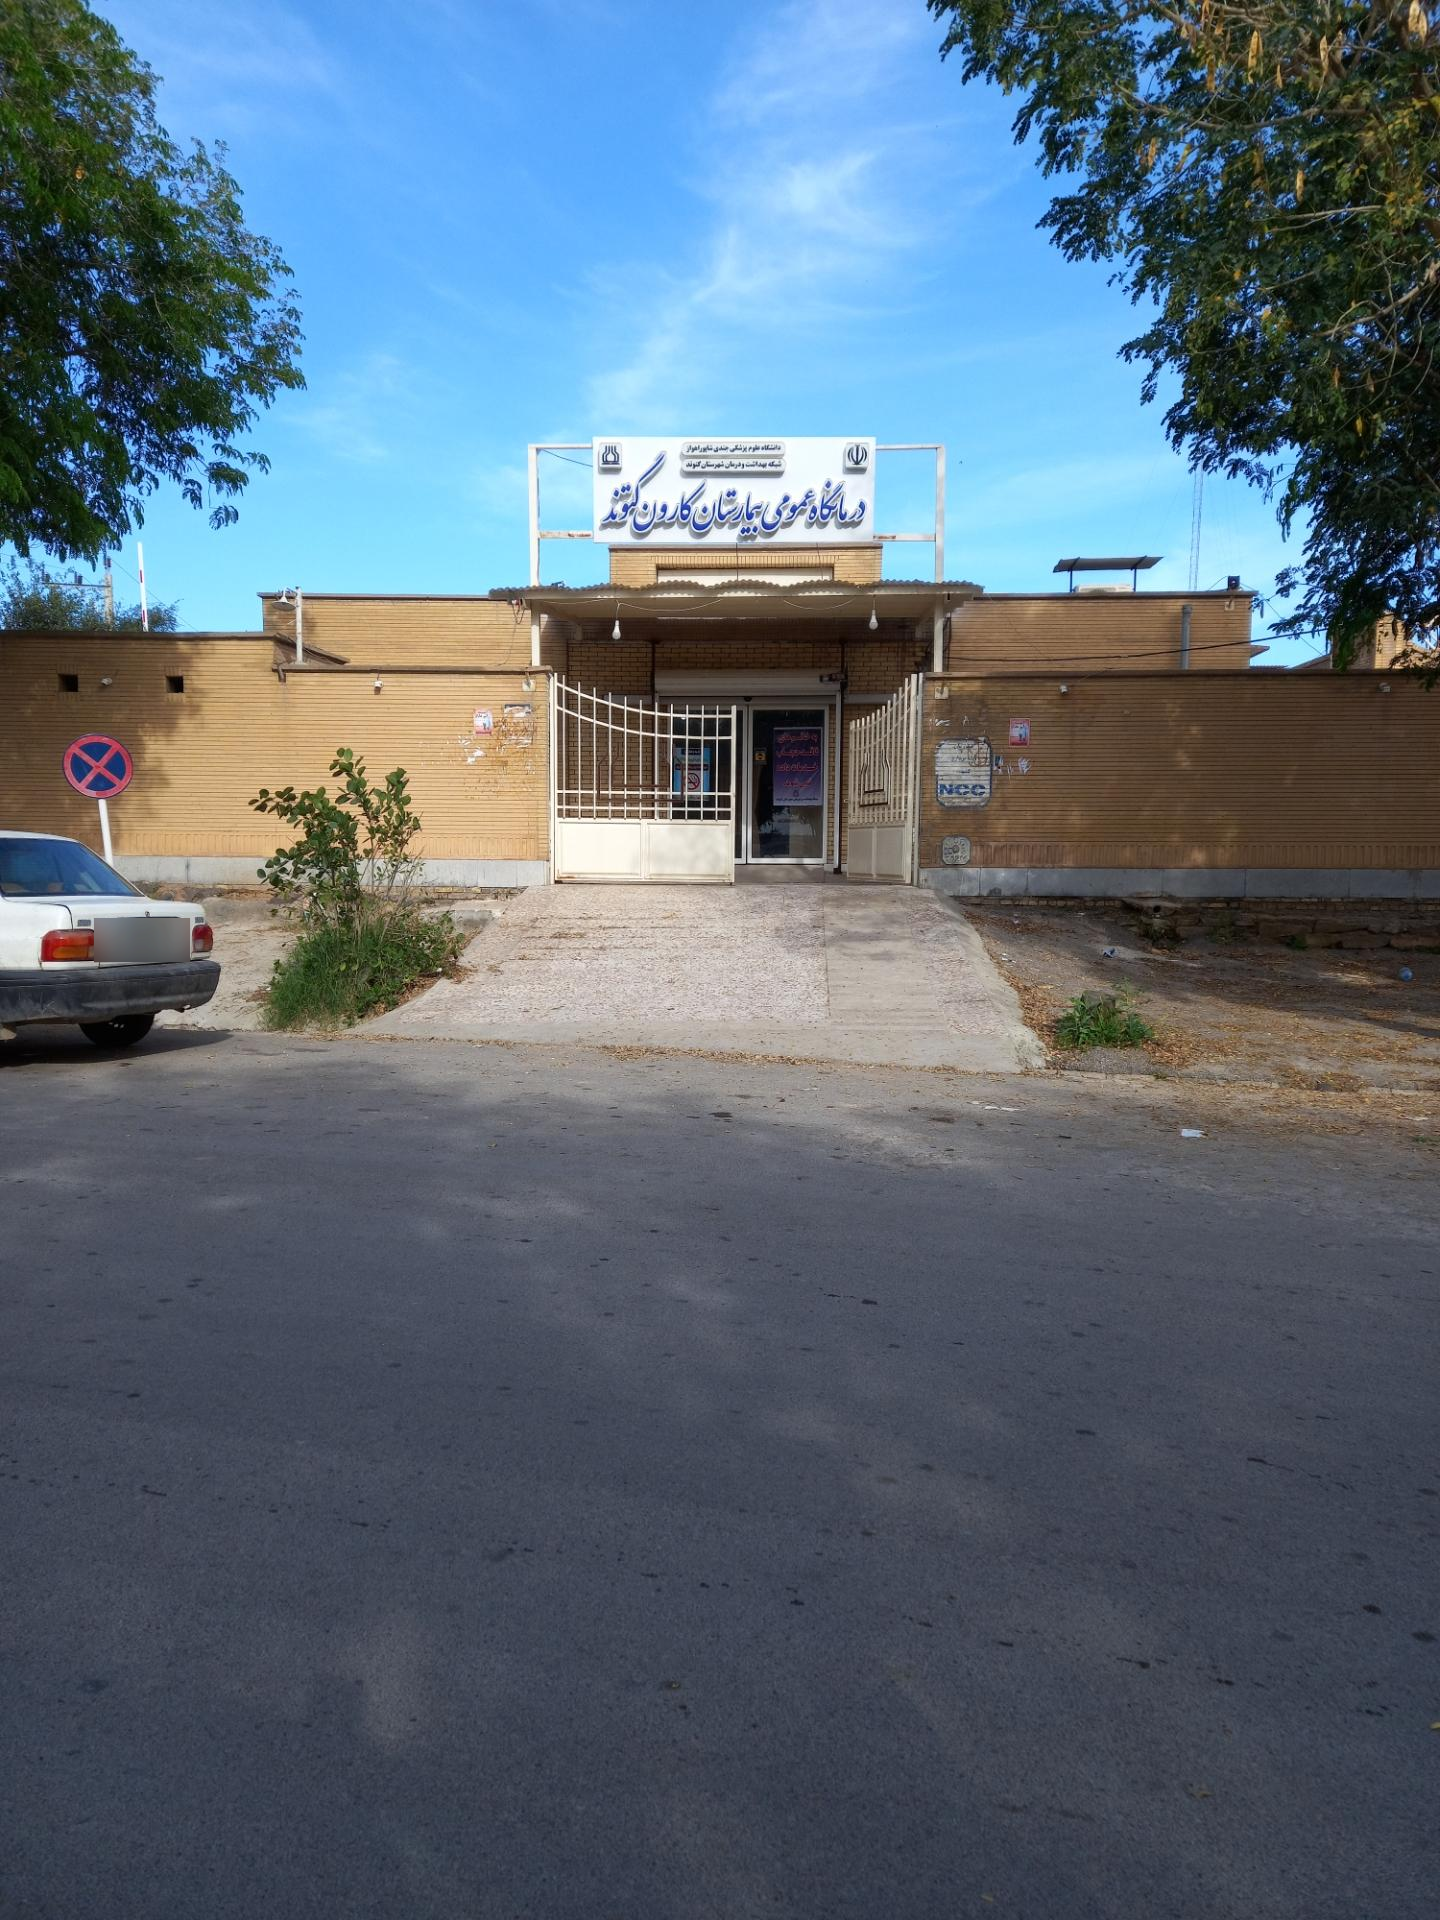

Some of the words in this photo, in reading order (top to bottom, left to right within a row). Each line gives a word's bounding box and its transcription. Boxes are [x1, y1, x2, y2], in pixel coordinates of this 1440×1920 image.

[713, 444, 729, 453] جندی
[729, 443, 748, 453] پزشکی
[748, 444, 760, 453] علوم
[760, 443, 782, 451] دانشگاه
[701, 460, 725, 470] شهرستان
[745, 460, 768, 469] بهداشت
[768, 460, 782, 468] شبکه
[600, 451, 666, 522] گتوند
[807, 478, 866, 521] درمانگاه
[632, 478, 706, 533] کارون
[760, 488, 816, 531] عمومی
[691, 487, 763, 535] بیمارستان
[938, 783, 987, 797] NCC
